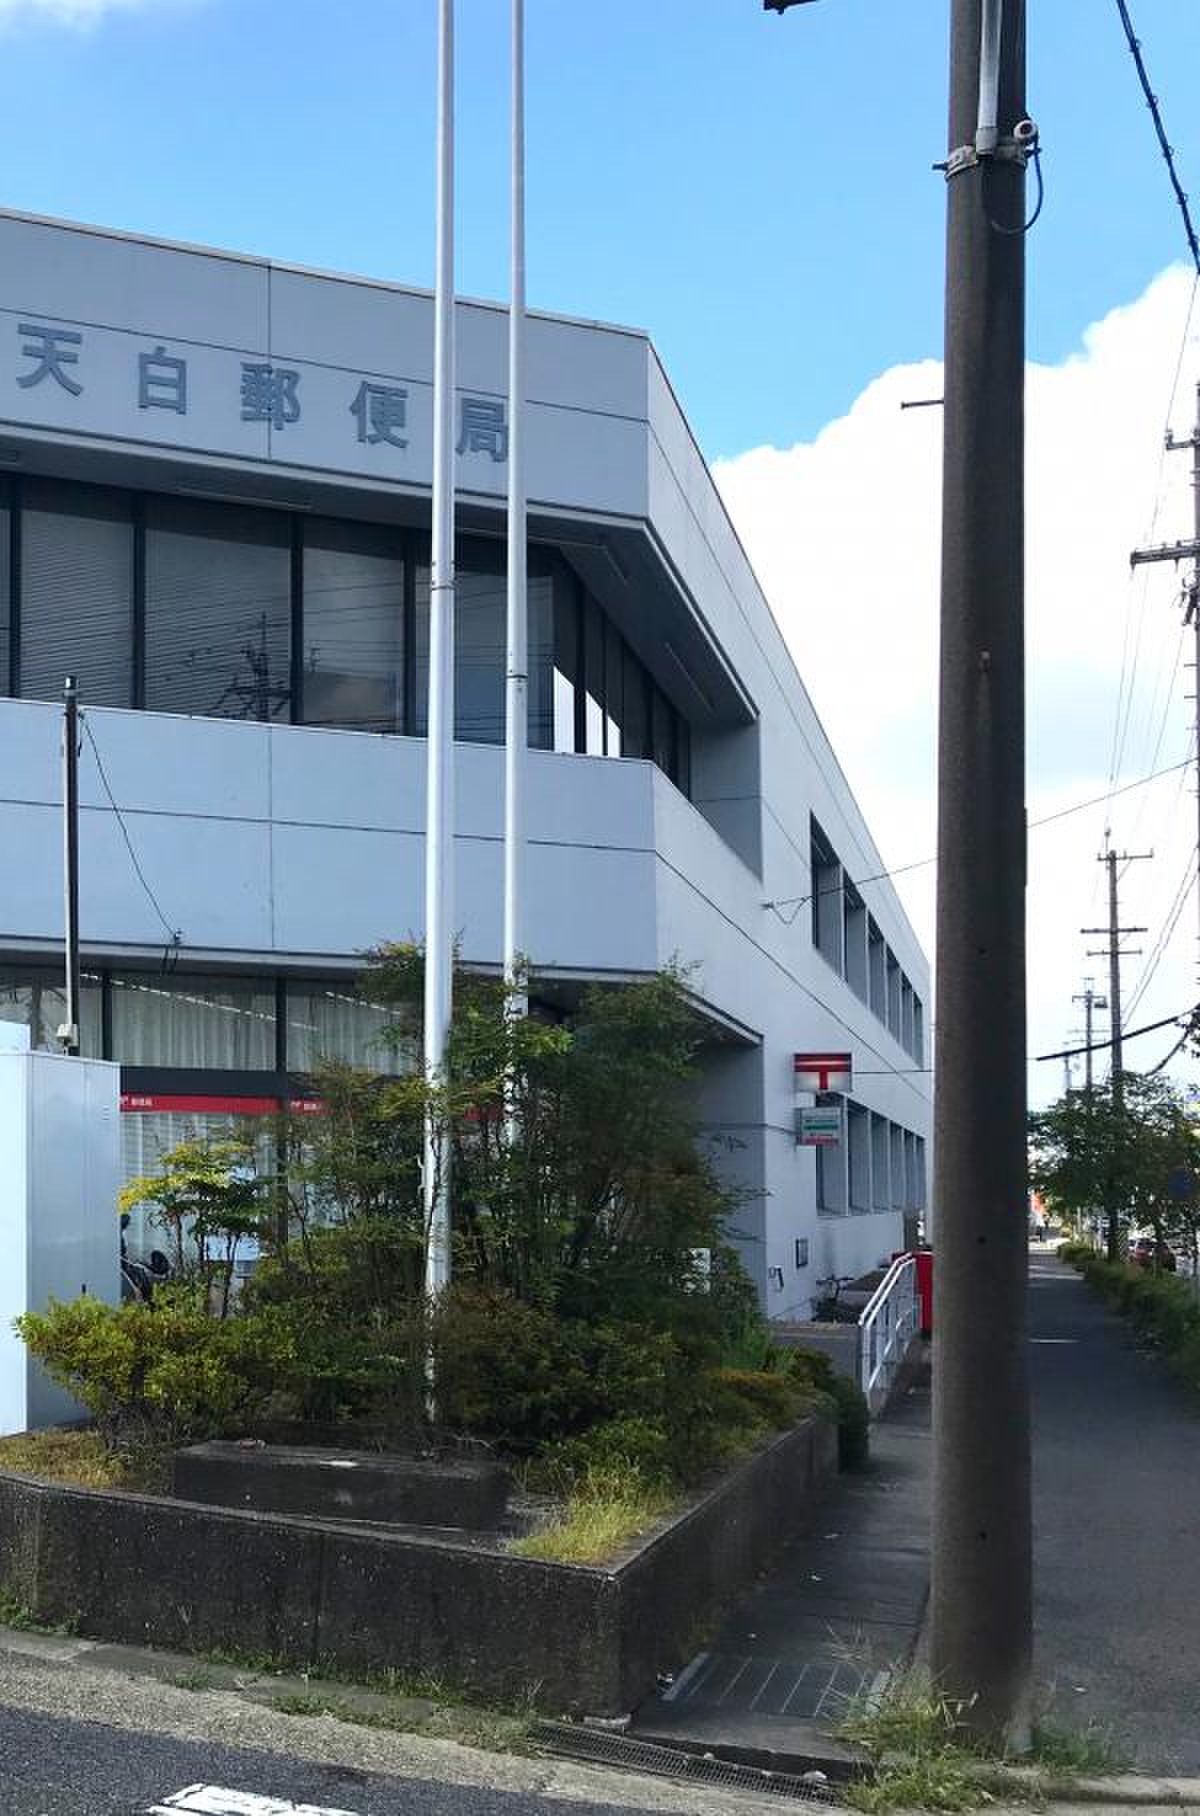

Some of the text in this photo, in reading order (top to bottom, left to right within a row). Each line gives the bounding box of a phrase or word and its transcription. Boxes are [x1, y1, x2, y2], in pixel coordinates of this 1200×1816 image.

[16, 322, 509, 463] 天白郵便局
